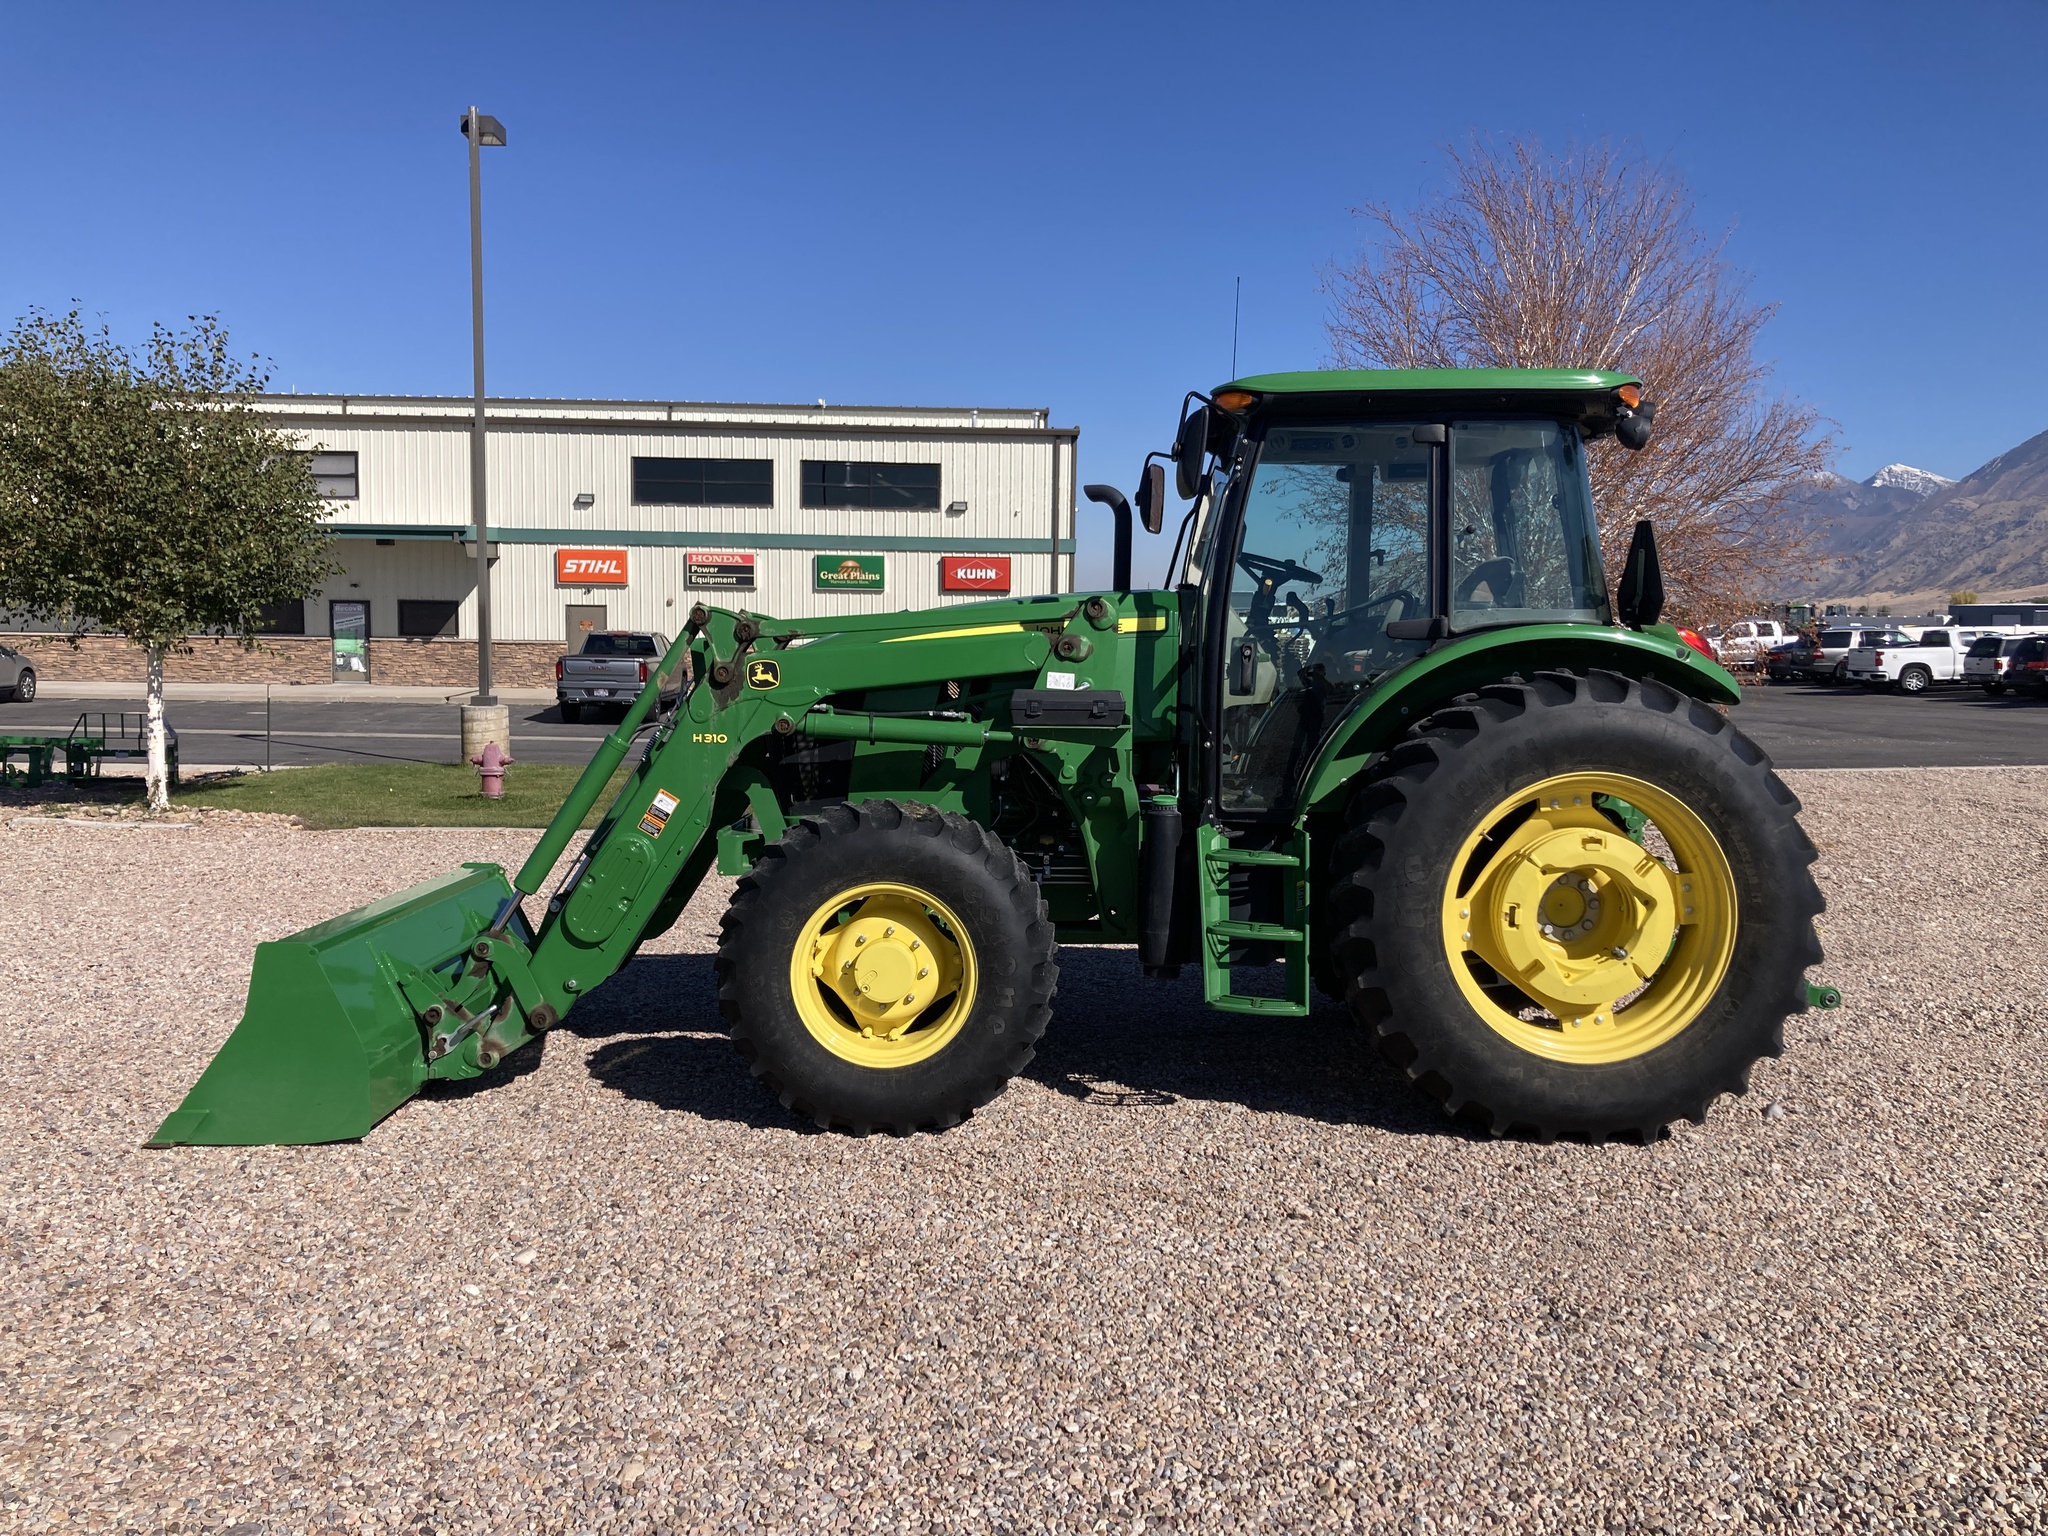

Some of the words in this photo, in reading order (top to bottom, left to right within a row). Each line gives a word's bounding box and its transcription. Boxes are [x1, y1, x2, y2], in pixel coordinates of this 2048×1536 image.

[691, 554, 743, 563] HONDA
[563, 559, 622, 574] STIHL
[691, 565, 718, 573] Power
[820, 571, 848, 580] Great
[850, 571, 880, 581] Plains
[957, 569, 996, 580] KUHN
[691, 575, 737, 585] Equipment
